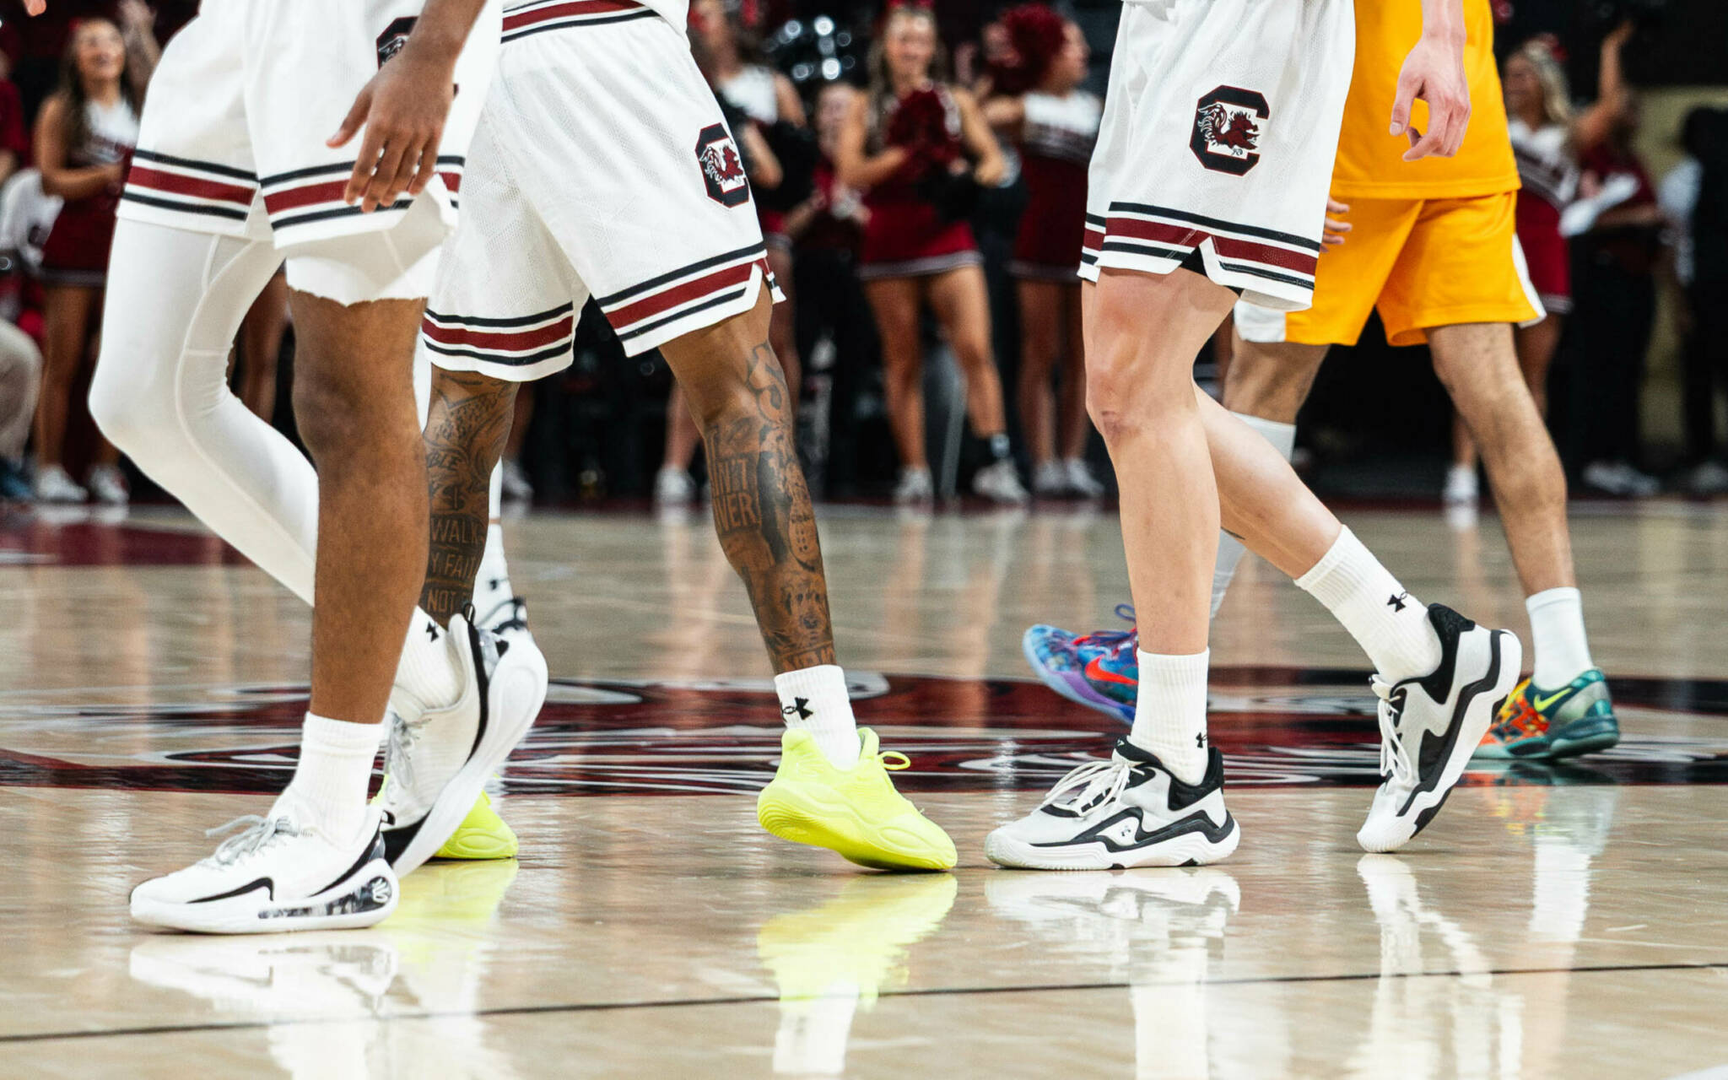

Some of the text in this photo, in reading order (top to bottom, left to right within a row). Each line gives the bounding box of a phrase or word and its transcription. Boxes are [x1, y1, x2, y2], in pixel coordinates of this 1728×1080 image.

[713, 492, 758, 534] VER
[430, 552, 481, 580] Y FAIT
[427, 589, 457, 616] NOT
